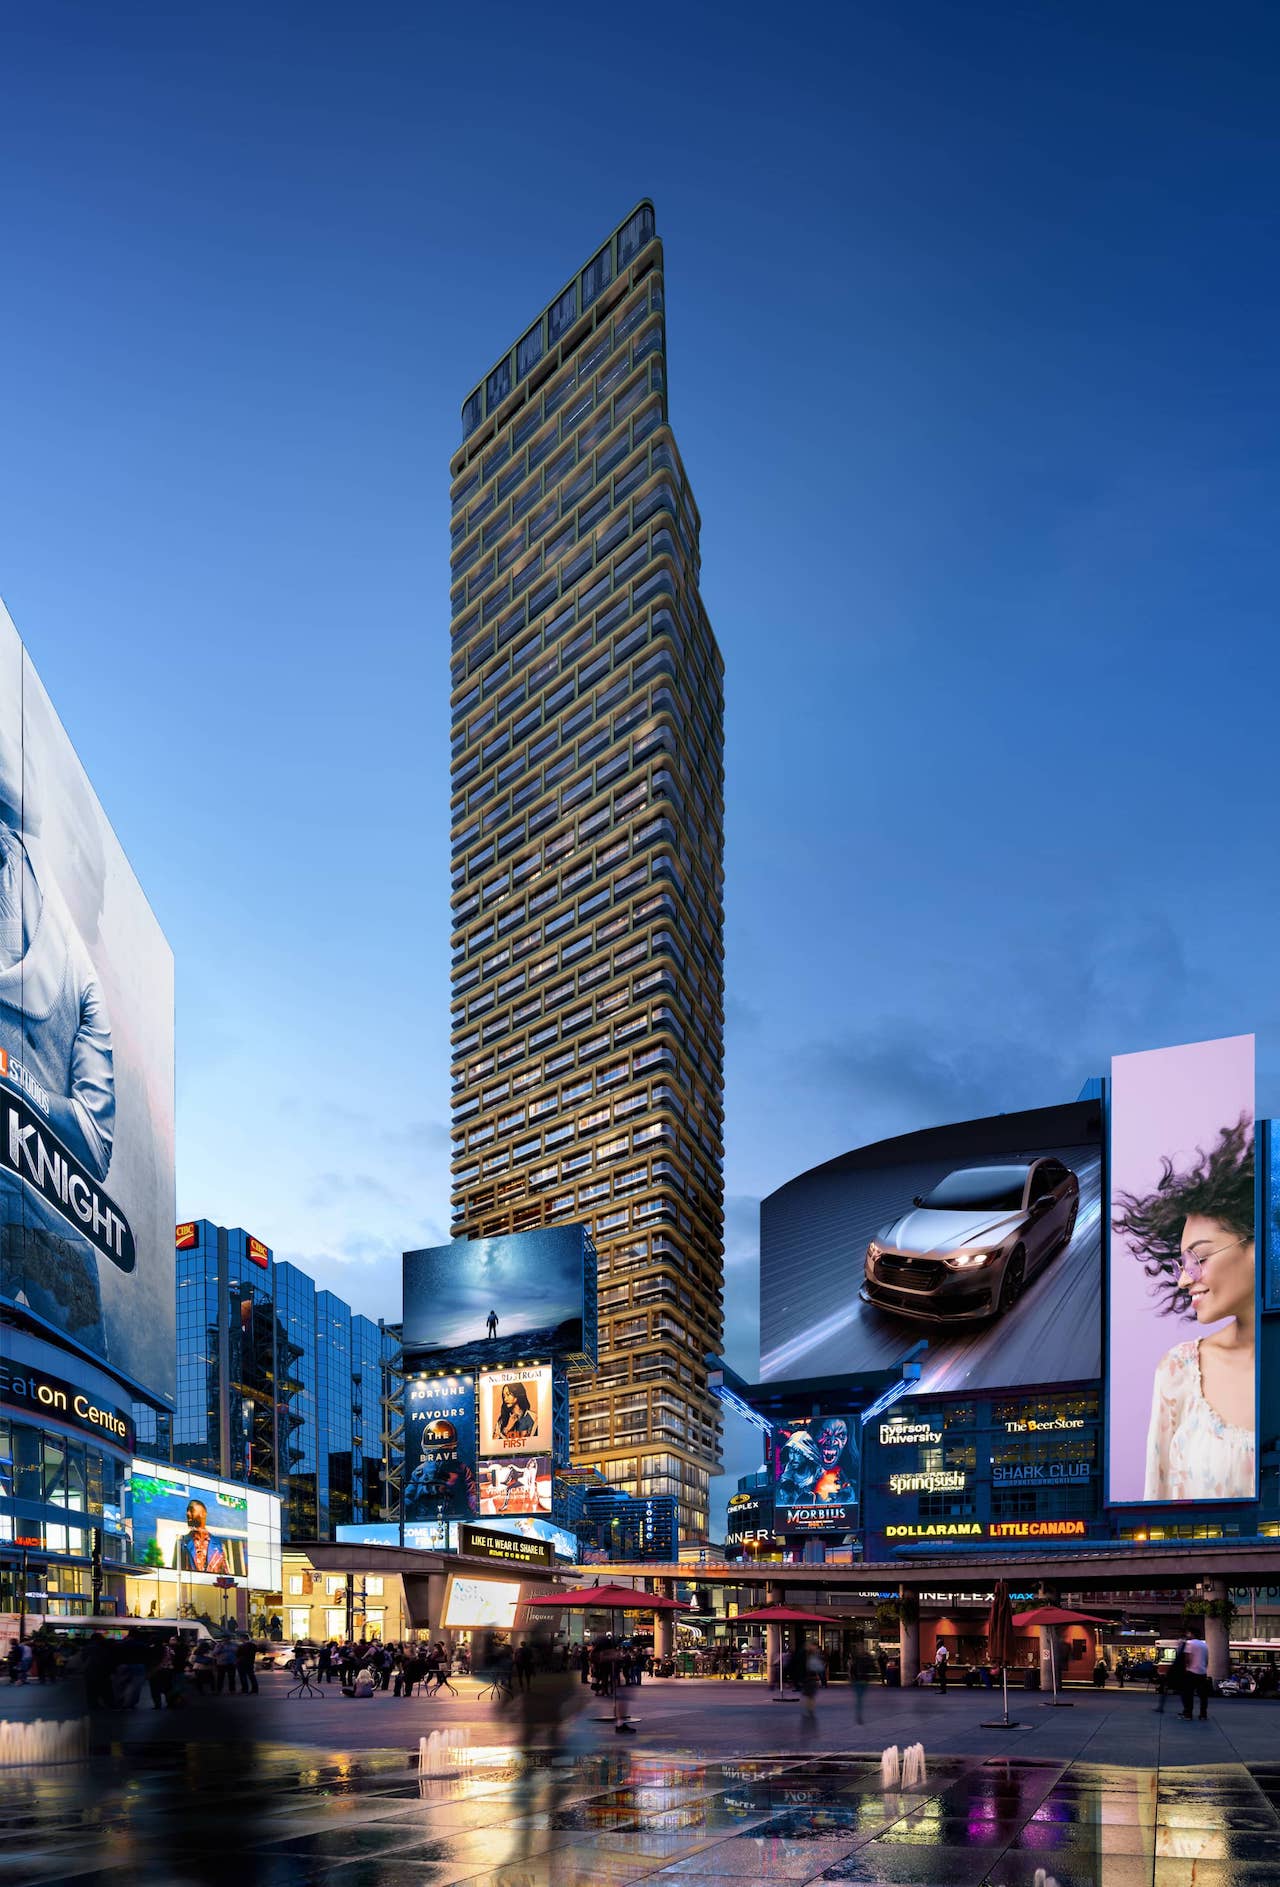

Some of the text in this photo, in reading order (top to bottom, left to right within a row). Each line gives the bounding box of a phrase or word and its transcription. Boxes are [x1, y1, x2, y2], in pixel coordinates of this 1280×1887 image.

[10, 1058, 49, 1114] STUDIOS
[9, 1108, 127, 1257] KNIGHT
[176, 1224, 194, 1237] CIBC
[251, 1239, 268, 1257] CIBC
[411, 1387, 465, 1400] FORTUNE
[0, 1365, 127, 1438] Eaton Centre
[412, 1408, 465, 1421] FAVOURS
[880, 1423, 931, 1437] Ryerson
[1005, 1422, 1027, 1433] The
[428, 1431, 449, 1441] THE
[880, 1432, 942, 1445] University
[503, 1439, 527, 1448] FIRST
[420, 1452, 458, 1462] BRAVE
[993, 1463, 1090, 1480] SHARK CLUB
[890, 1475, 934, 1495] spring
[934, 1471, 965, 1487] sushi
[727, 1502, 759, 1514] CINEPLEX
[787, 1508, 846, 1524] MORBIUS
[886, 1523, 982, 1536] DOLLARAMA
[725, 1529, 776, 1546] INNERS
[471, 1535, 486, 1547] LIKE
[495, 1539, 512, 1551] WEAR
[520, 1543, 538, 1555] SHARE
[919, 1592, 995, 1601] INEPLEX
